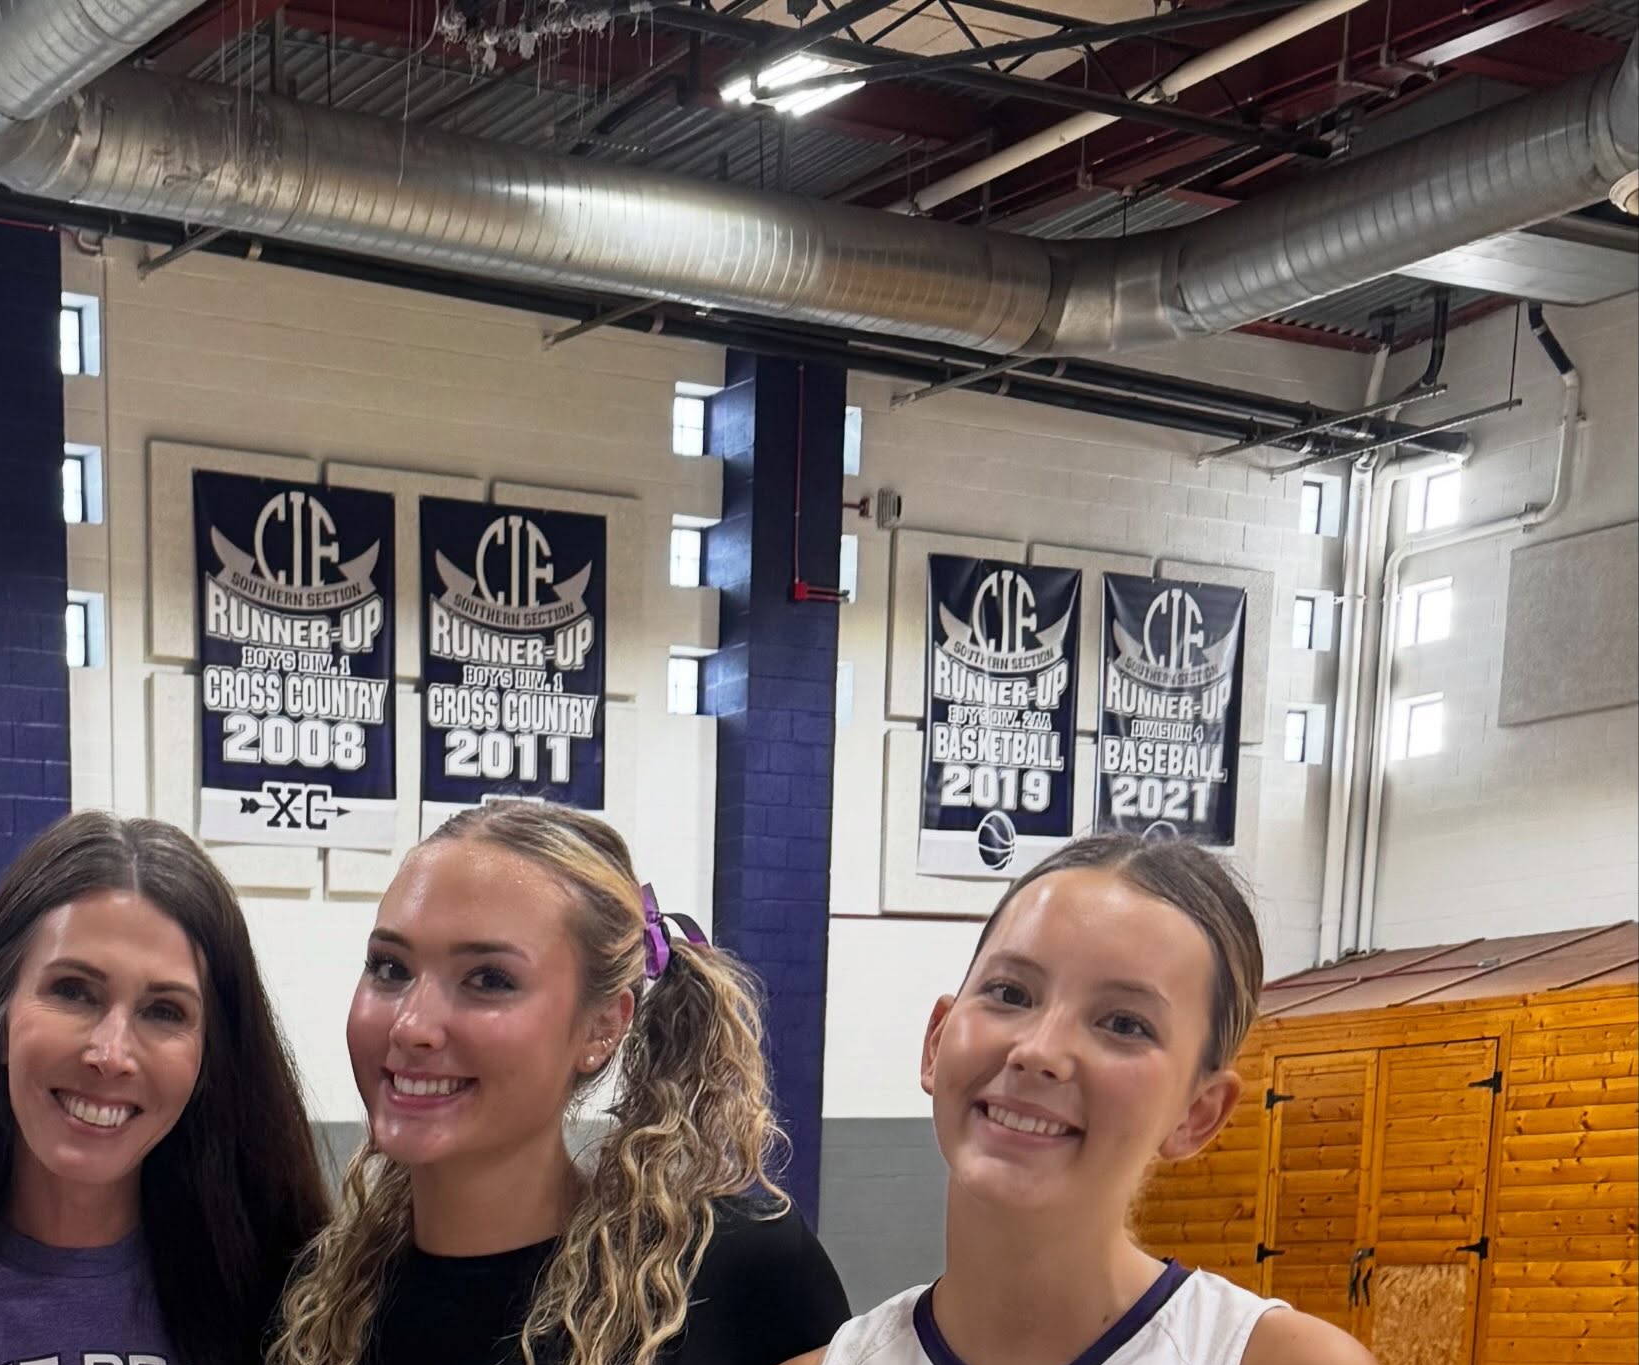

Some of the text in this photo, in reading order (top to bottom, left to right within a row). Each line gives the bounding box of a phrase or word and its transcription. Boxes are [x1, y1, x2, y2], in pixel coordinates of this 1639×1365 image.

[254, 491, 340, 588] CIF
[476, 516, 554, 608] CIF
[206, 575, 383, 651] RUNNER-UP
[233, 571, 362, 607] SOUTHERN SECTION
[455, 593, 574, 626] SOUTHERN SECTION
[972, 570, 1037, 653] CIF
[430, 596, 594, 669] RUNNER-UP
[1144, 589, 1204, 669] CIF
[242, 646, 296, 671] BOYS
[298, 652, 338, 675] DIV.
[463, 665, 513, 688] BOYS
[515, 669, 551, 692] DIV.
[934, 643, 1068, 709] RUNNER-UP
[204, 665, 388, 724] CROSS COUNTRY
[428, 683, 599, 737] CROSS COUNTRY
[1105, 657, 1231, 723] RUNNER-UP
[222, 713, 365, 770] 2008
[445, 729, 571, 783] 2011
[933, 723, 1064, 770] BASKETBALL
[1102, 736, 1227, 782] BASEBALL
[267, 787, 327, 830] XC
[941, 765, 1051, 812] 2019
[1111, 776, 1211, 822] 2021
